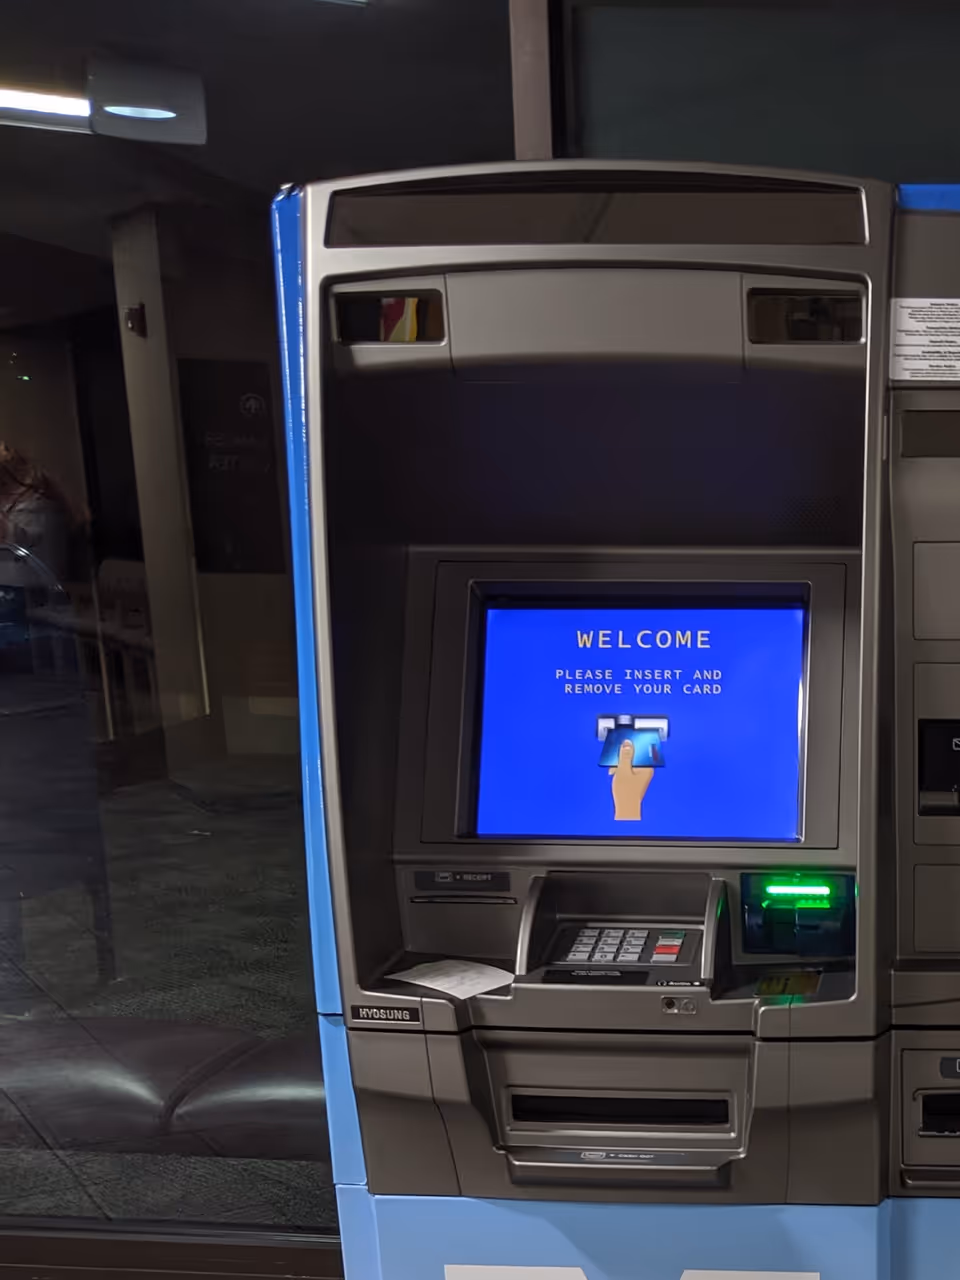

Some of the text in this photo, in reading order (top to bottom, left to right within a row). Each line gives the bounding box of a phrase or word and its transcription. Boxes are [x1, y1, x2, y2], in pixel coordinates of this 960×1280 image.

[576, 630, 712, 649] WELCOME
[555, 669, 722, 680] PLEASE INSERT AND
[564, 683, 722, 694] REMOVE YOUR CARD
[463, 873, 492, 881] RECEIPT
[358, 1007, 410, 1020] HYOSUNG
